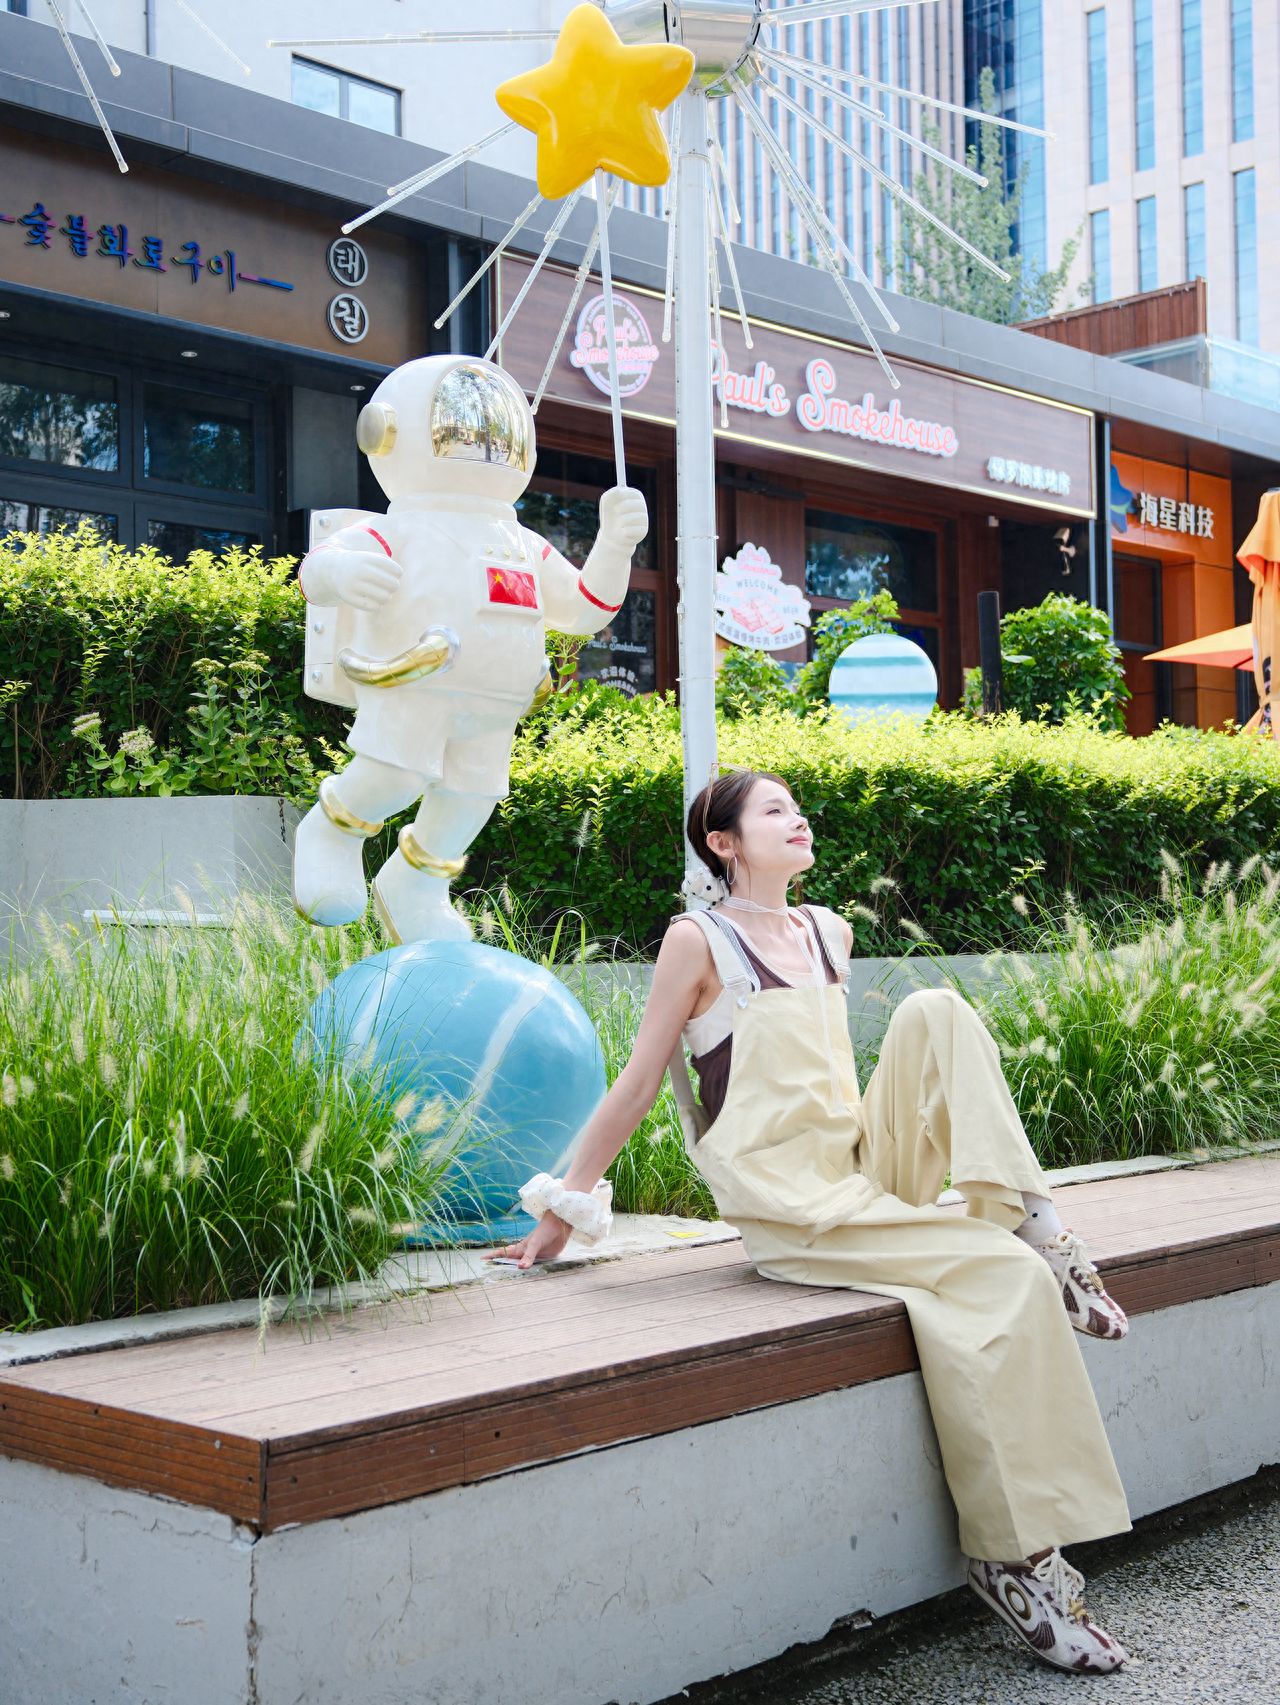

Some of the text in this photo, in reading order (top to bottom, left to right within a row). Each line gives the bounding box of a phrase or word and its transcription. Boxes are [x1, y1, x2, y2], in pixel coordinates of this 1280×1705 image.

[18, 202, 236, 292] 숯불화로구이
[796, 358, 960, 459] Smokehouse
[1139, 491, 1215, 540] 海星科技
